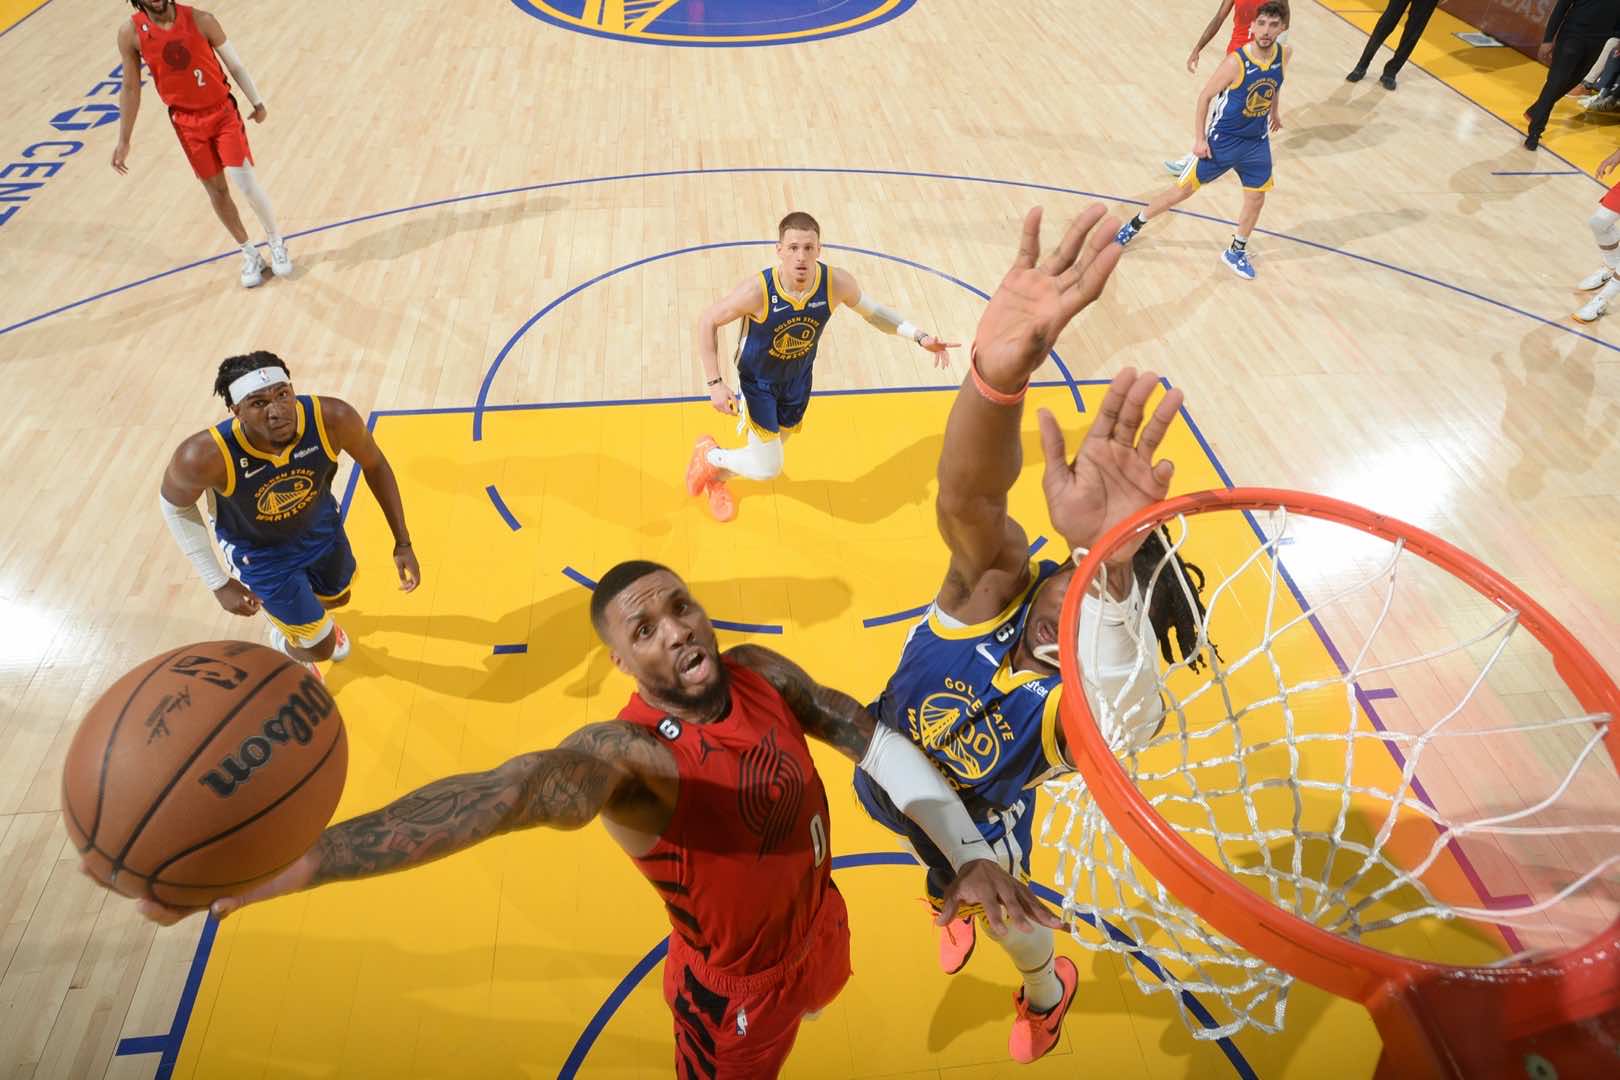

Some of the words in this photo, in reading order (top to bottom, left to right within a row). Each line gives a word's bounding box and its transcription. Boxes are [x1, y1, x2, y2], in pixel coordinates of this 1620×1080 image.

[193, 68, 206, 87] 2
[801, 329, 811, 340] 0
[239, 457, 249, 468] 6
[294, 480, 305, 491] 5
[996, 623, 1015, 643] 6
[944, 676, 984, 713] GOLE
[198, 674, 335, 798] Wilson
[658, 718, 681, 740] 6
[810, 813, 827, 869] 0
